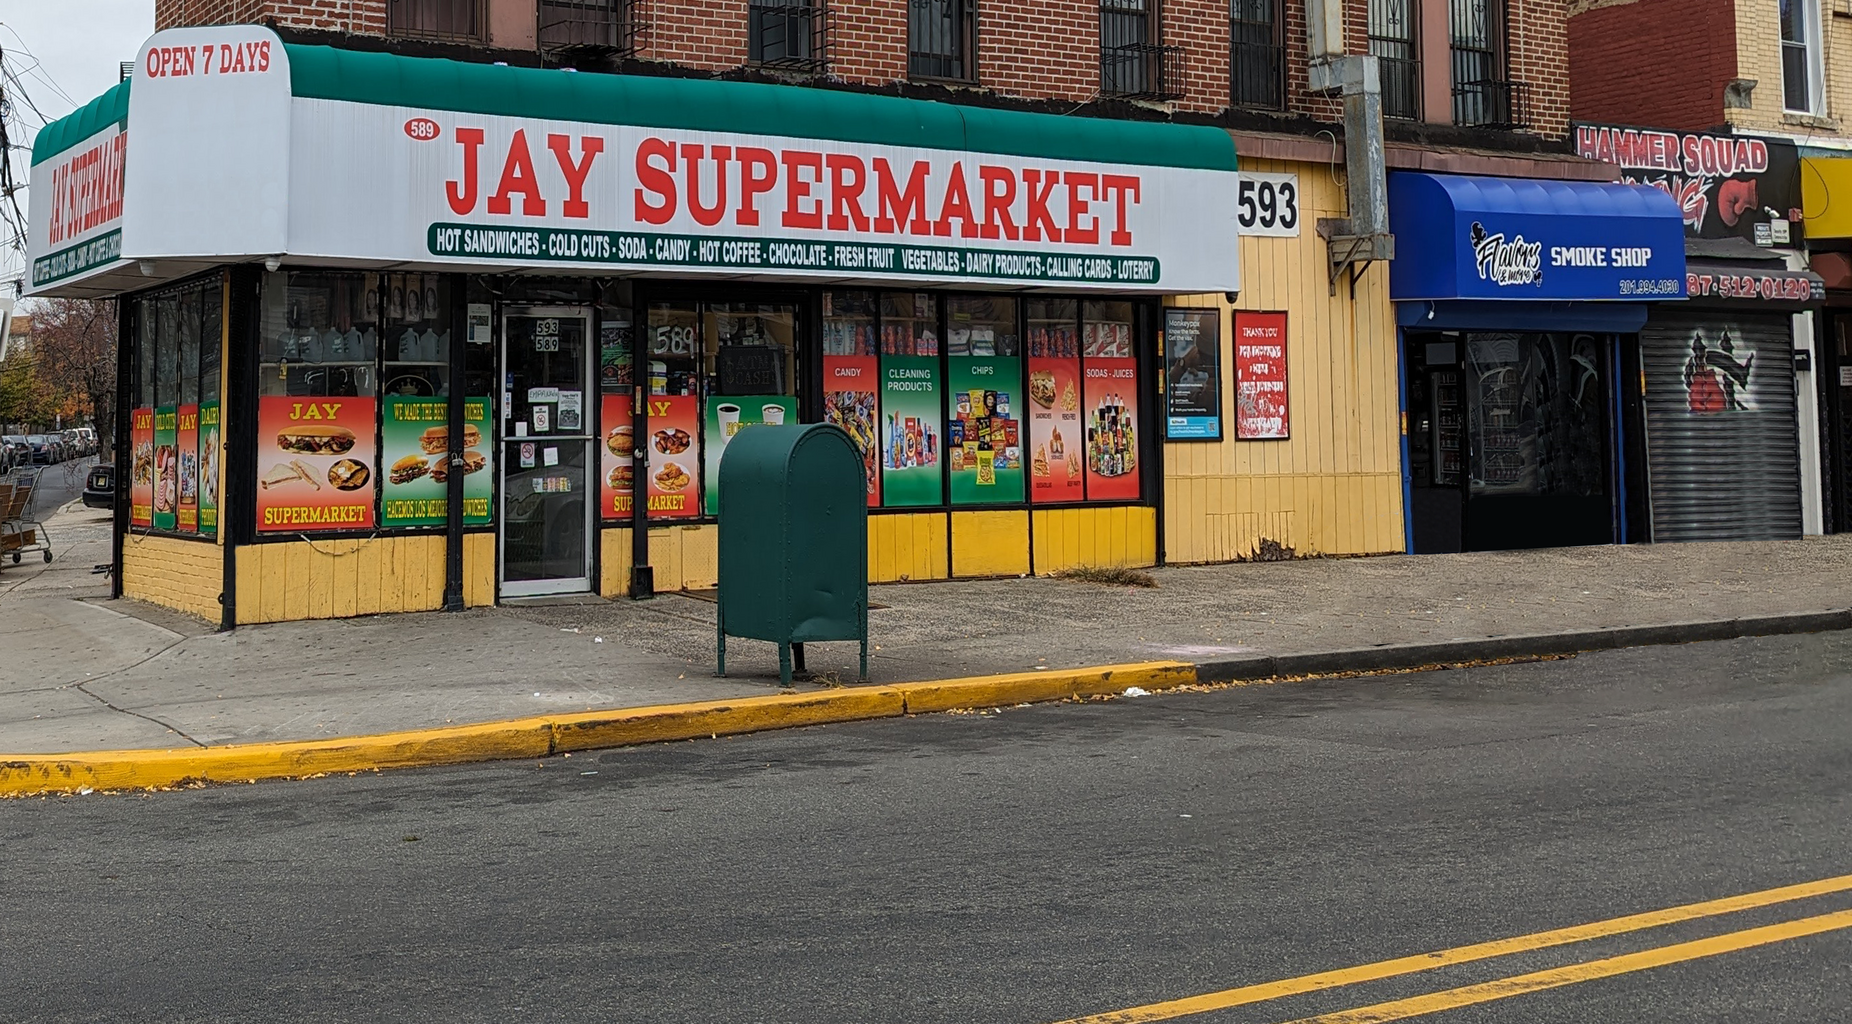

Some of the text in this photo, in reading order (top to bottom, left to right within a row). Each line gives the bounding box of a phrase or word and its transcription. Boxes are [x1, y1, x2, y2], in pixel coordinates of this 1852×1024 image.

[146, 40, 271, 79] OPEN 7 DAYS
[410, 121, 434, 138] 589
[1576, 125, 1769, 177] HAMMER SQUAD
[445, 127, 1140, 247] JAY SUPERMARKET
[49, 163, 69, 247] JAY
[1237, 180, 1297, 229] 593
[436, 228, 1155, 280] HOT SANDWICHES COLD CUTS SODA CANDY HOT COFFEE CHOCOLATE FRESH FRUIT VEGETABLES DAIRY PRODUCTS CALLING CARDS LOTERRY
[1477, 233, 1541, 279] Flavors
[1551, 246, 1652, 267] SMOKE SHOP
[537, 321, 558, 334] 593
[1168, 319, 1201, 329] Monkeypox
[1242, 327, 1279, 337] THANK YOU
[537, 338, 558, 351] 589
[653, 325, 695, 360] 589
[735, 356, 770, 370] ATM
[971, 365, 994, 375] CHIPS
[735, 371, 771, 385] CASH
[834, 367, 862, 377] CANDY
[888, 368, 931, 379] CLEANING
[1086, 368, 1134, 378] SODAS JUICES
[887, 381, 933, 391] PRODUCTS
[289, 403, 342, 420] JAY
[136, 414, 151, 429] JAY
[179, 414, 197, 430] JAY
[613, 495, 685, 512] SUPMARKET
[264, 506, 367, 525] SUPERMARKET
